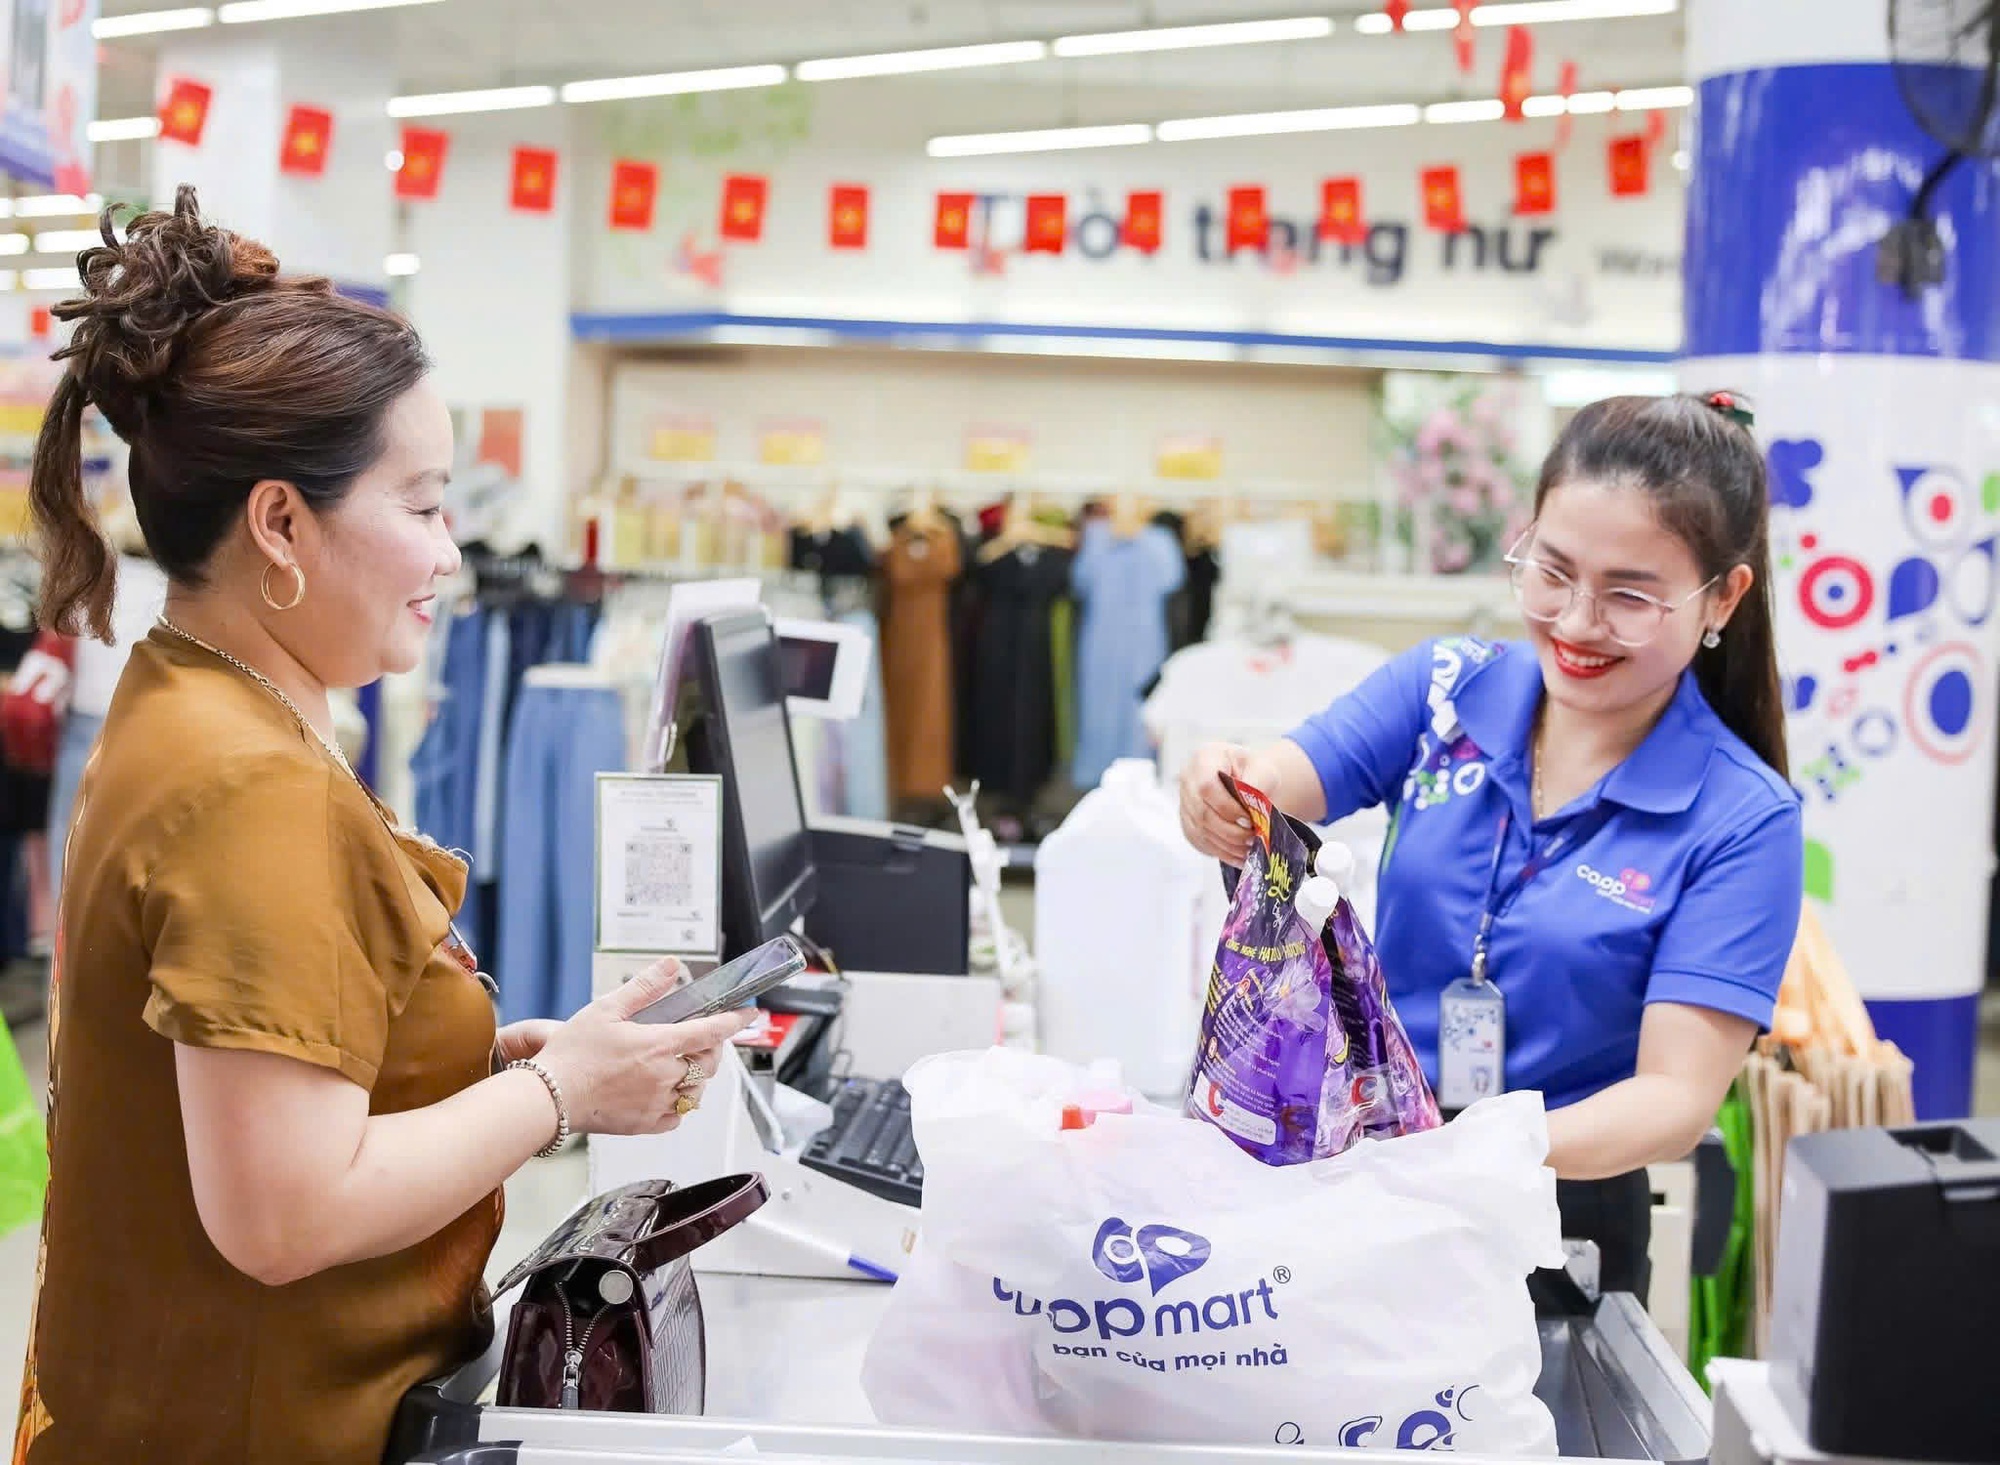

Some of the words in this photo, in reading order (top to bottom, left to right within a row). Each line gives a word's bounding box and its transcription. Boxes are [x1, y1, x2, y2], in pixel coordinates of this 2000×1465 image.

[1052, 1343, 1108, 1359] bạn
[1116, 1350, 1165, 1373] của
[1175, 1351, 1226, 1371] mọi
[1236, 1342, 1288, 1367] nhà
